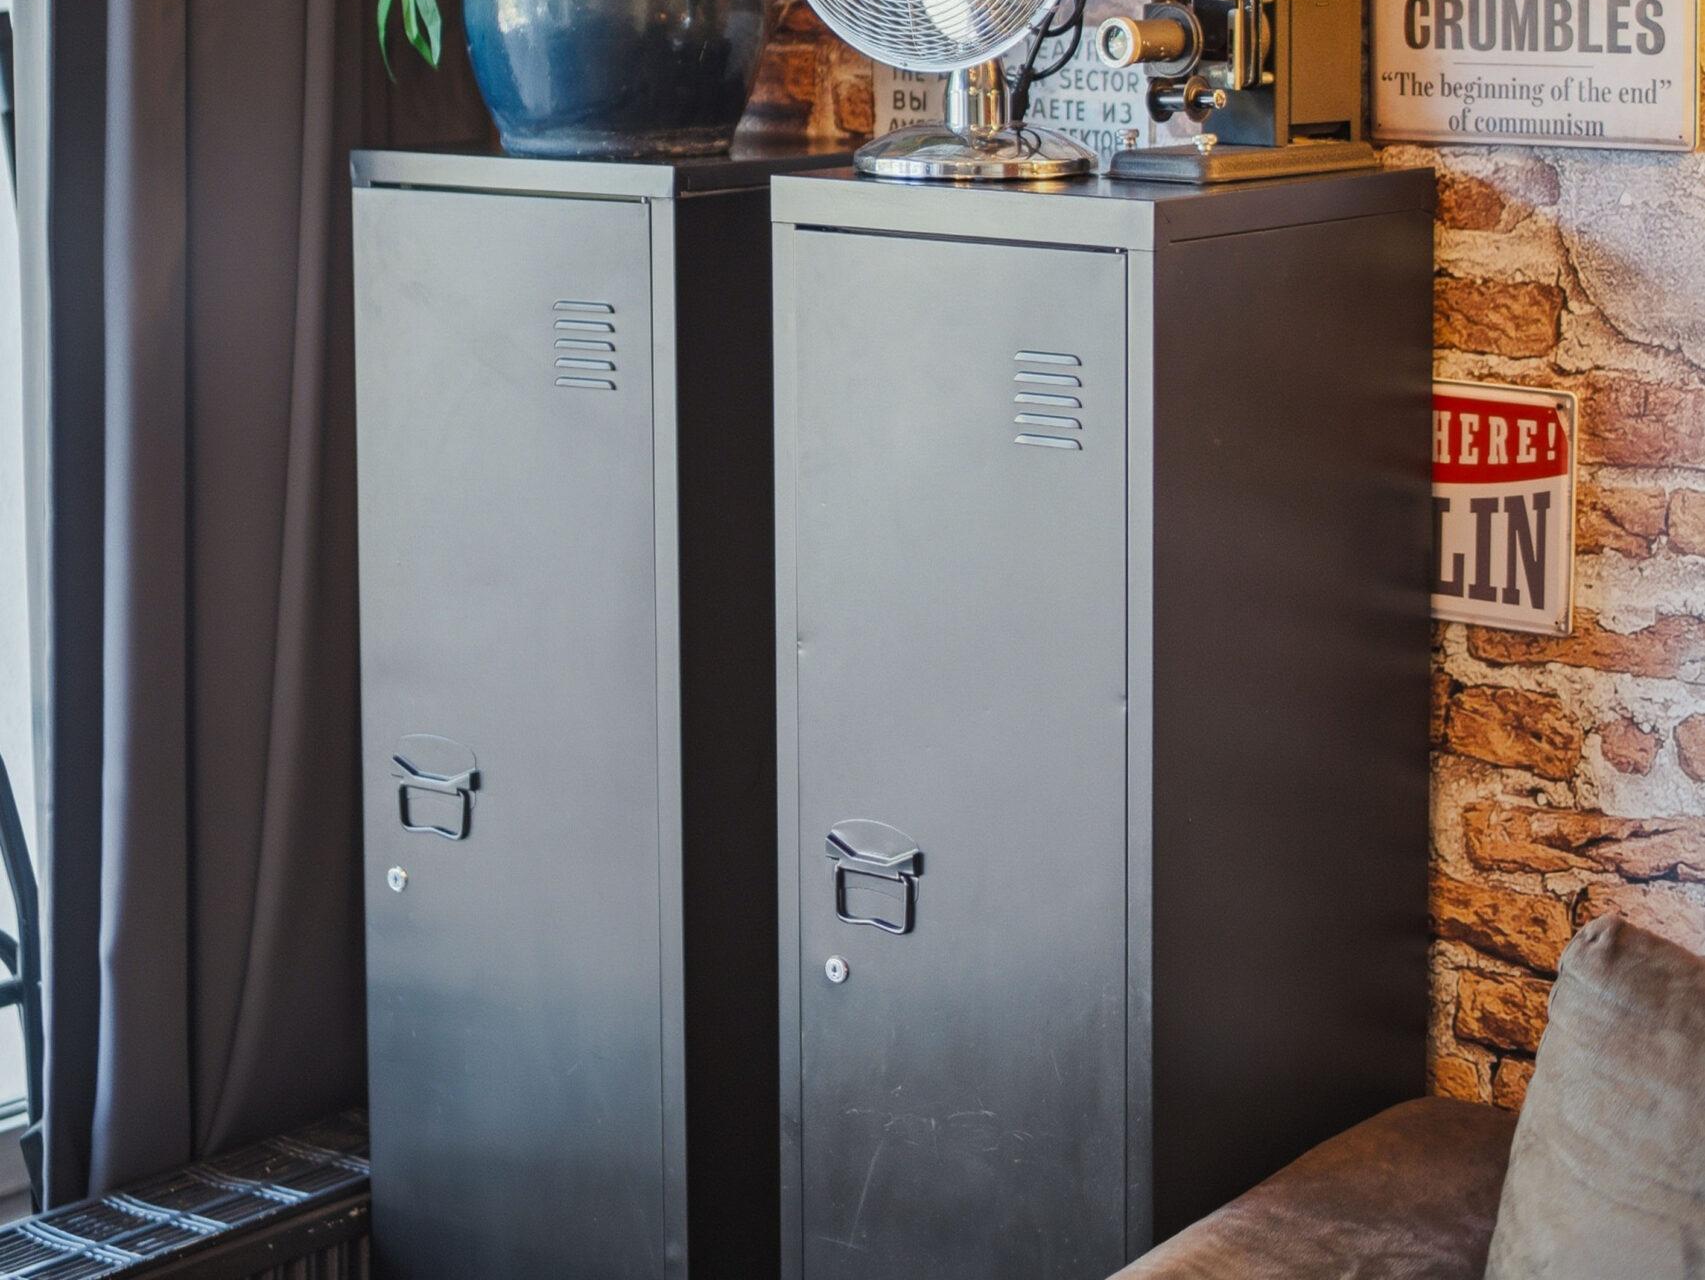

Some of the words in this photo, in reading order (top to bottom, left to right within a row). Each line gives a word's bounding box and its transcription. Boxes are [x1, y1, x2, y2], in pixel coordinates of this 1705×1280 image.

[1059, 68, 1141, 93] SECTOR
[1440, 74, 1545, 108] beginning
[1550, 76, 1575, 103] of
[1578, 80, 1613, 104] the
[1448, 108, 1471, 133] of
[1475, 113, 1606, 139] communism
[1433, 409, 1556, 465] HERE!
